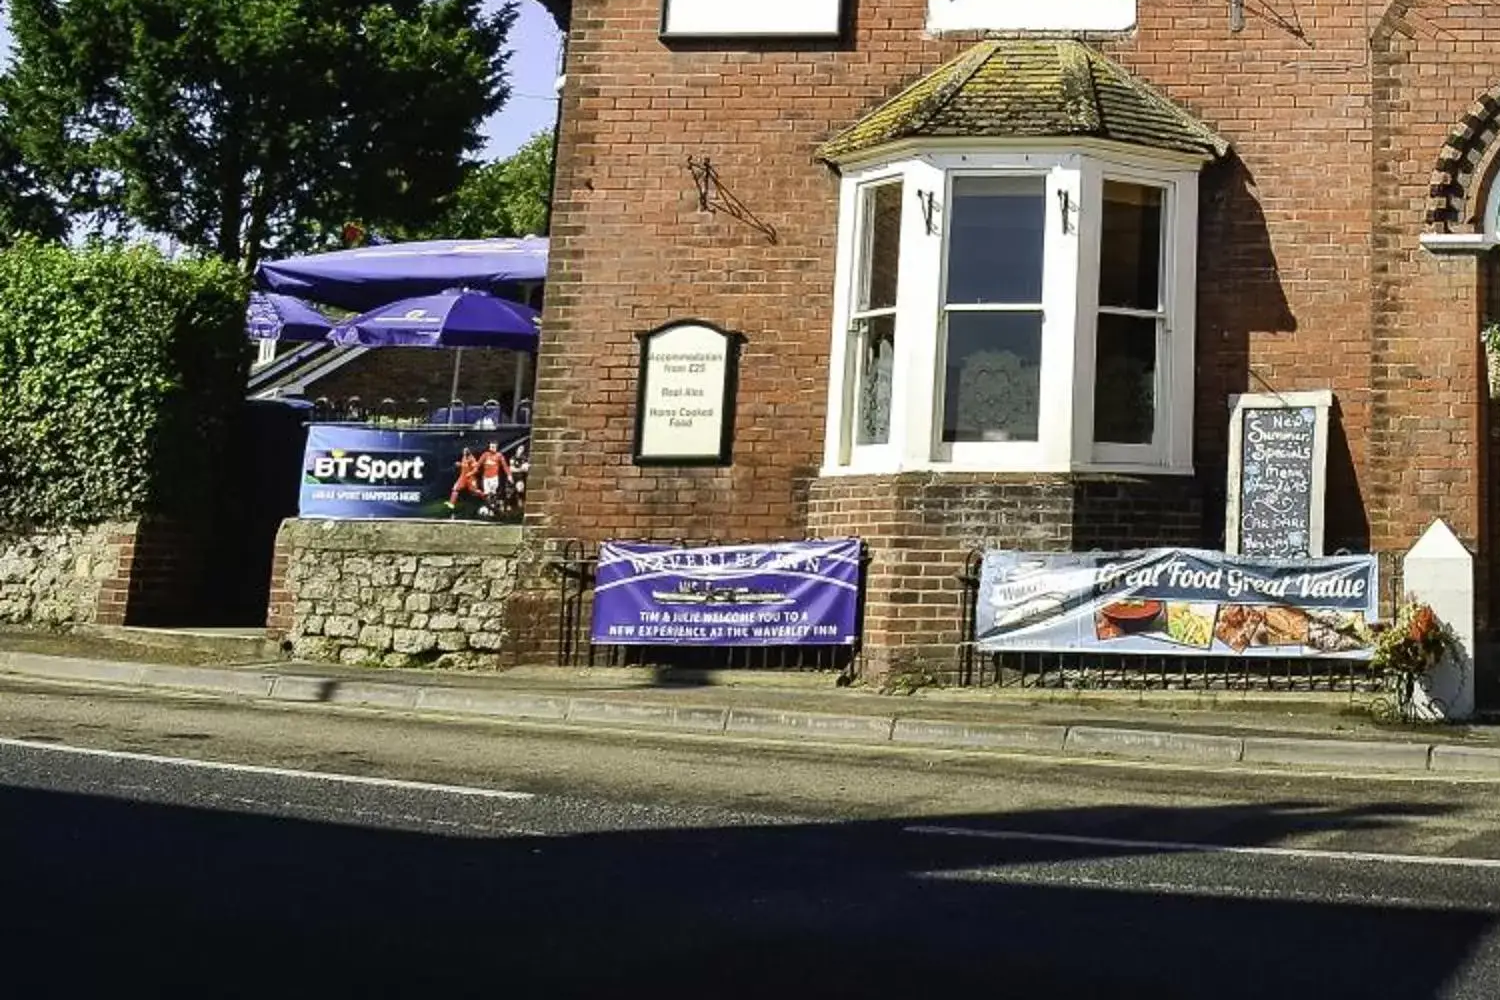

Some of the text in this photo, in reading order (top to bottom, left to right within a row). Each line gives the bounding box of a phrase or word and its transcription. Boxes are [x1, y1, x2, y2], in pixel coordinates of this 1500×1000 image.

[314, 455, 424, 482] BT Sport
[633, 553, 821, 574] WAVERLEY INN
[1097, 561, 1365, 598] Great Food Great Value
[640, 611, 660, 623] TIM
[662, 612, 671, 622] &
[703, 611, 757, 623] WELCOME
[758, 611, 781, 623] YOU
[783, 611, 799, 622] TO
[801, 611, 809, 621] A
[608, 624, 837, 638] NEW EXPERIENCE AT THE WAVERLEY INN
